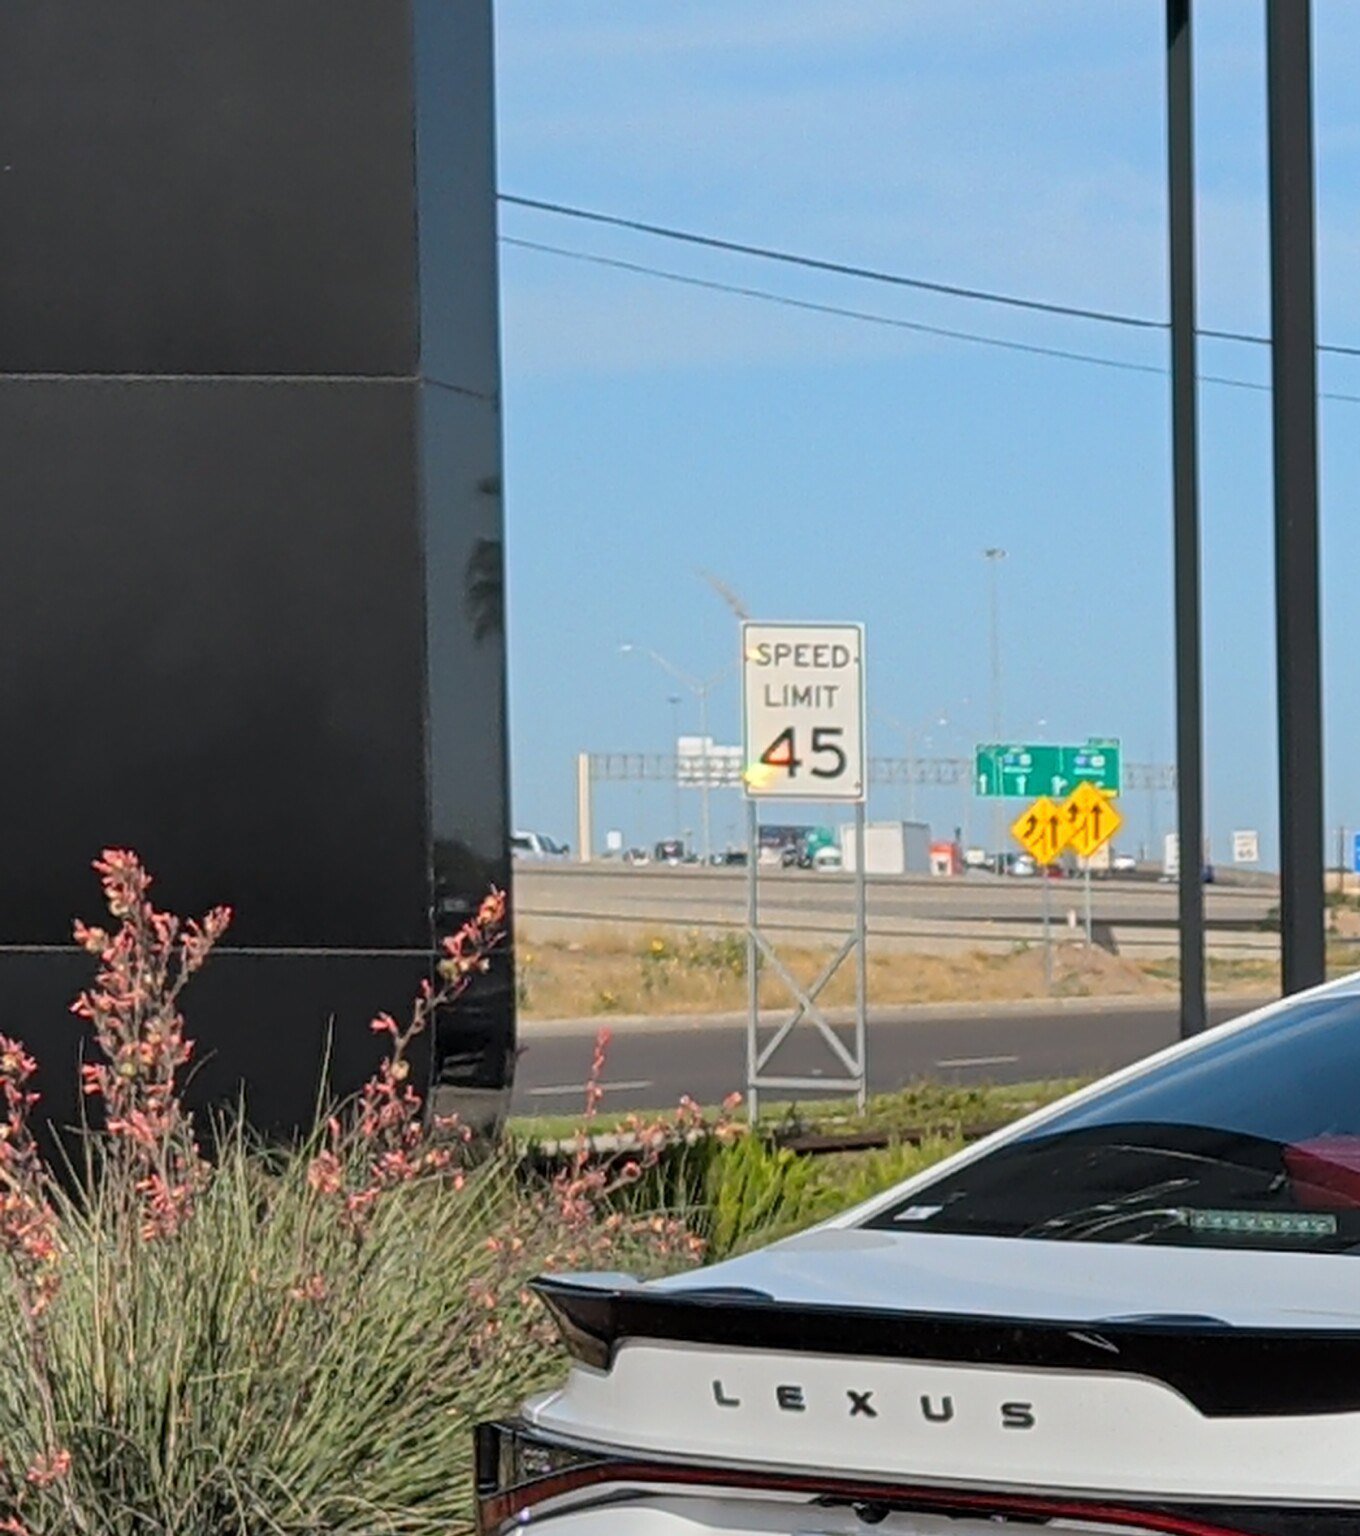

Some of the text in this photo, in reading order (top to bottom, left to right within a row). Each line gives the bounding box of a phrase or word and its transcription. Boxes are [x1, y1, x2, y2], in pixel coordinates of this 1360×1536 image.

[756, 643, 850, 668] SPEED
[764, 683, 840, 709] LIMIT
[760, 726, 848, 779] 45
[712, 1380, 1035, 1430] LEXUS
